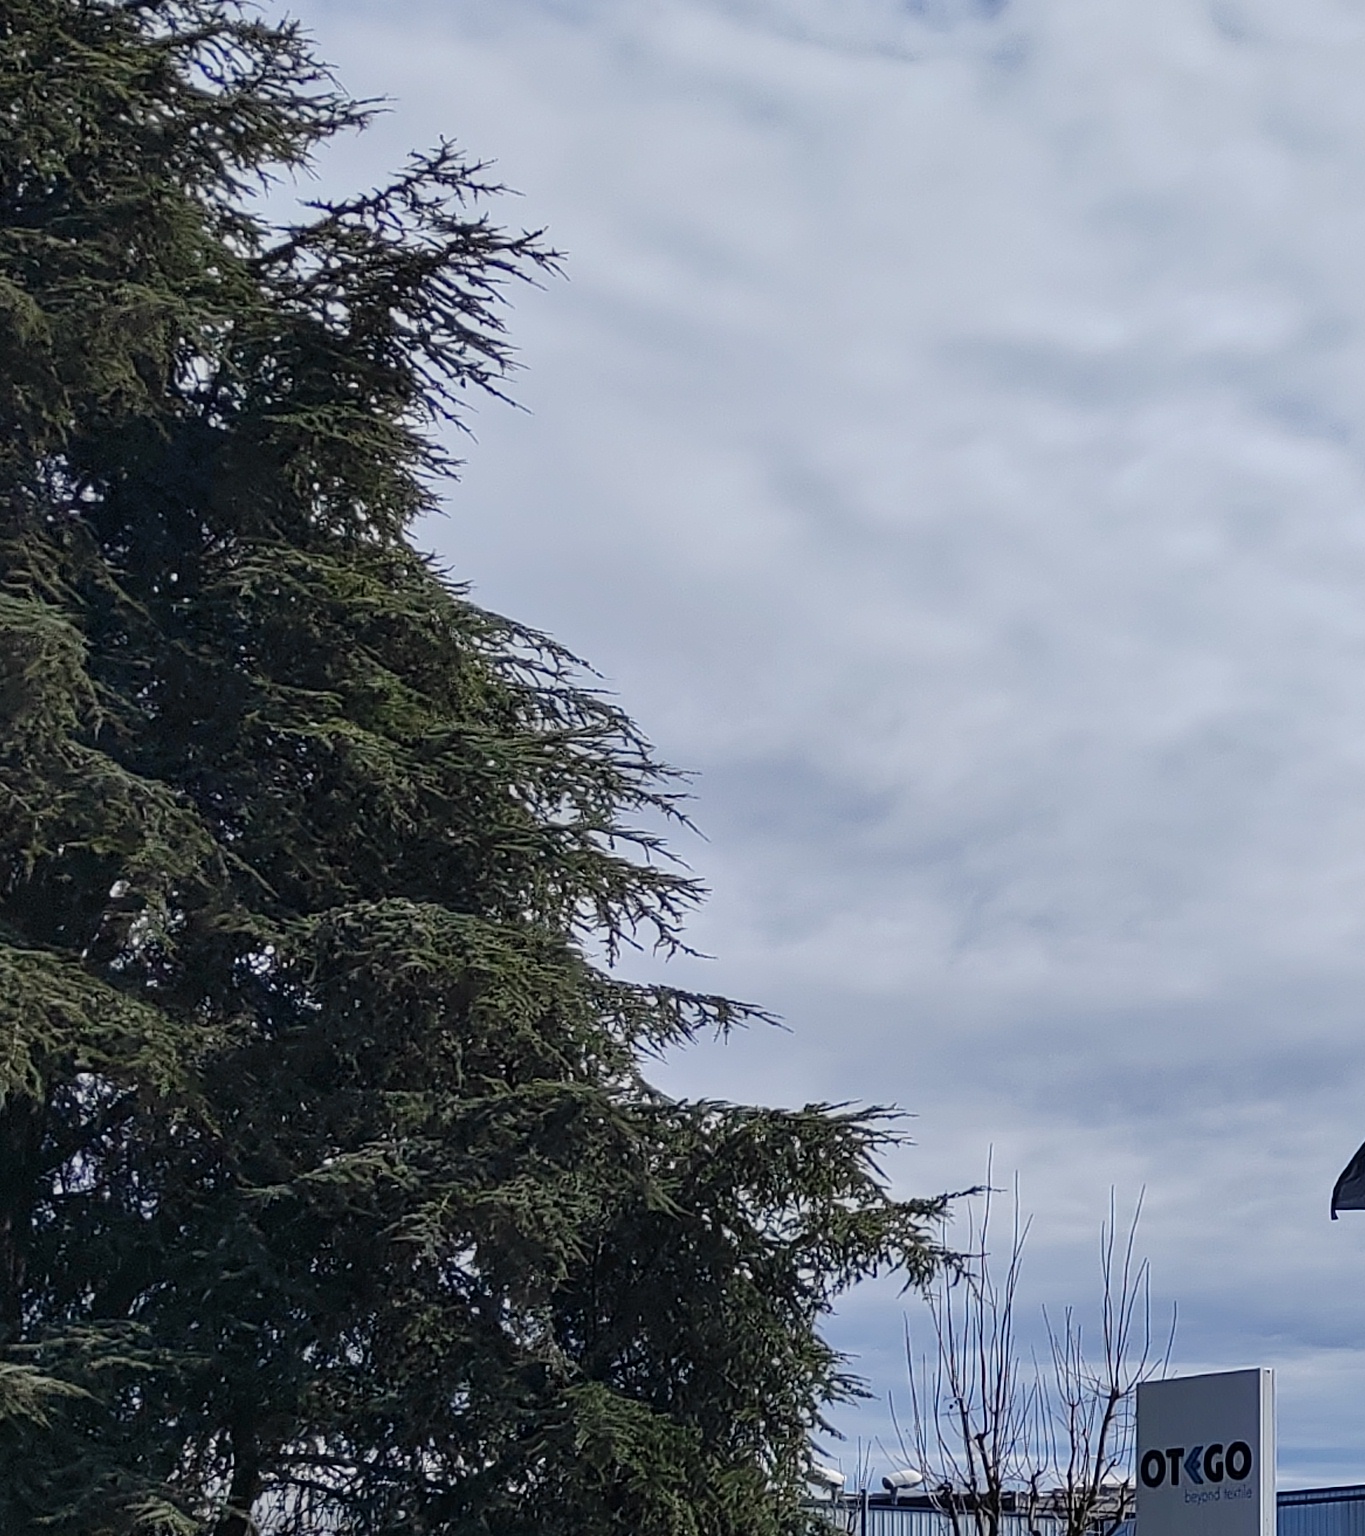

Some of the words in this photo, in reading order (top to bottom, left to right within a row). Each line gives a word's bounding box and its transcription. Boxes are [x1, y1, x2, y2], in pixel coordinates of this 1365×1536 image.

[1140, 1441, 1252, 1488] OTEGO
[1184, 1487, 1220, 1505] beyond
[1224, 1484, 1252, 1500] textile
